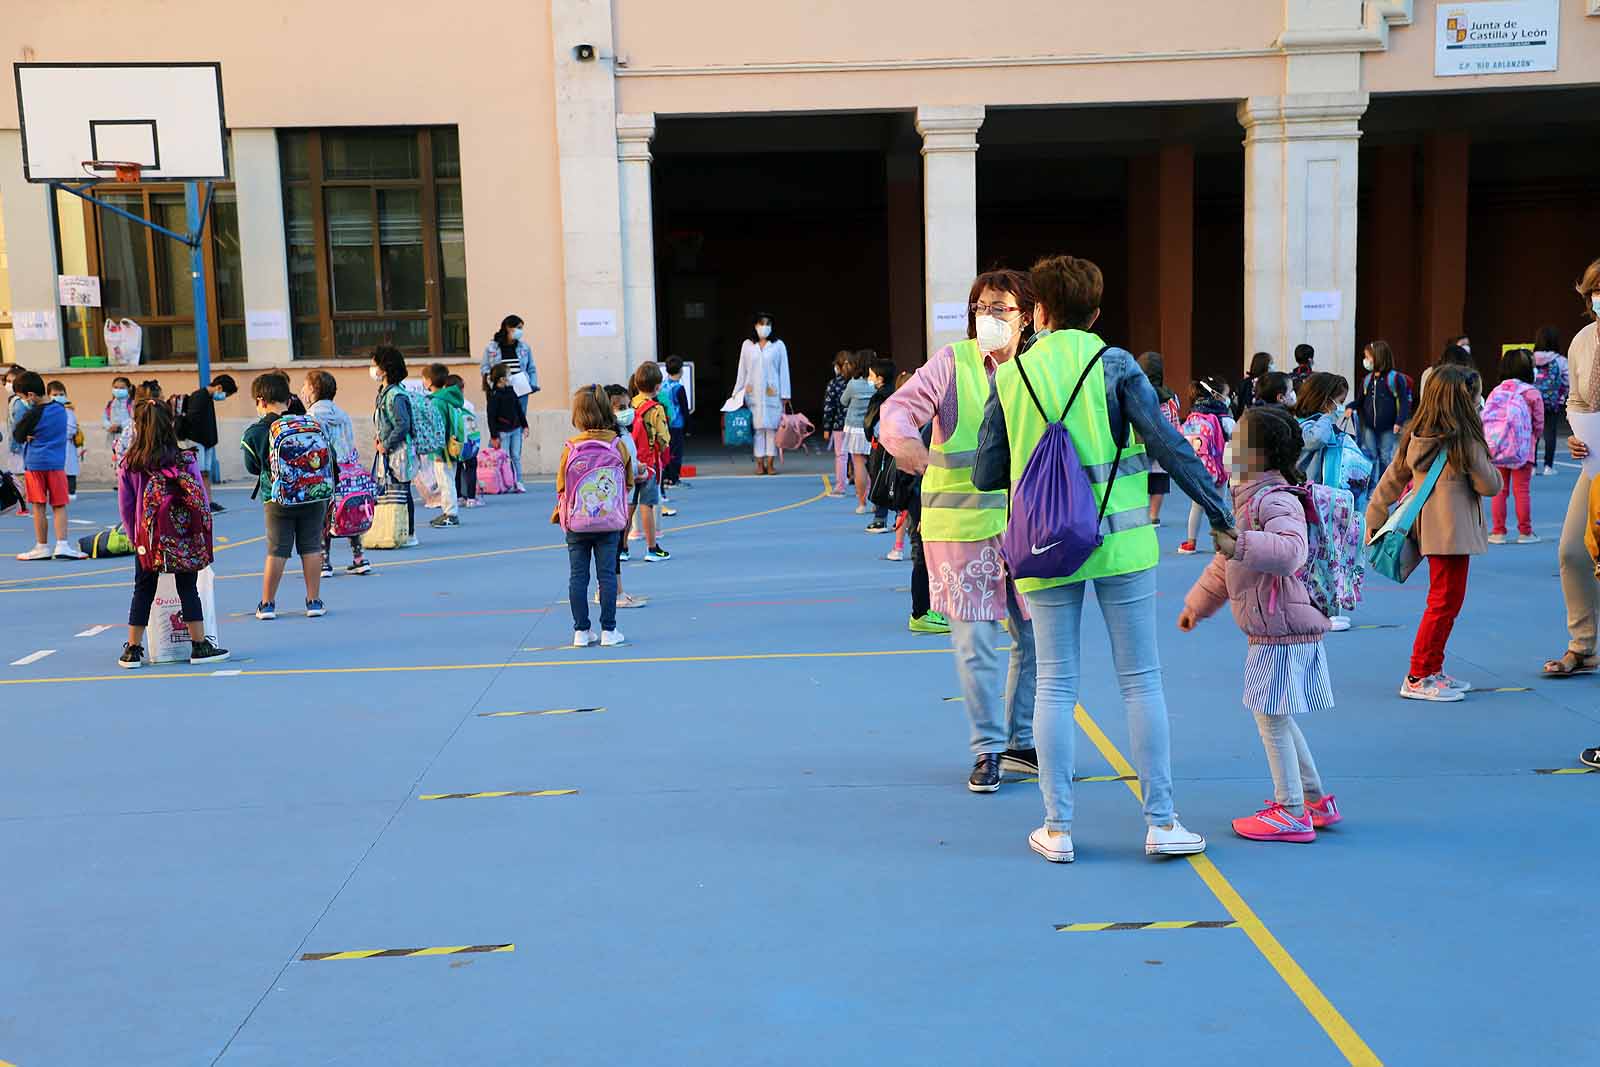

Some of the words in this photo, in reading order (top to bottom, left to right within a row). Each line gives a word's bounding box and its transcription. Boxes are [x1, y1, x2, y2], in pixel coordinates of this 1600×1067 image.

[1471, 21, 1500, 30] Junta
[1504, 20, 1518, 29] de
[1470, 30, 1508, 40] Castilla
[1511, 31, 1518, 41] y
[1521, 29, 1548, 38] León
